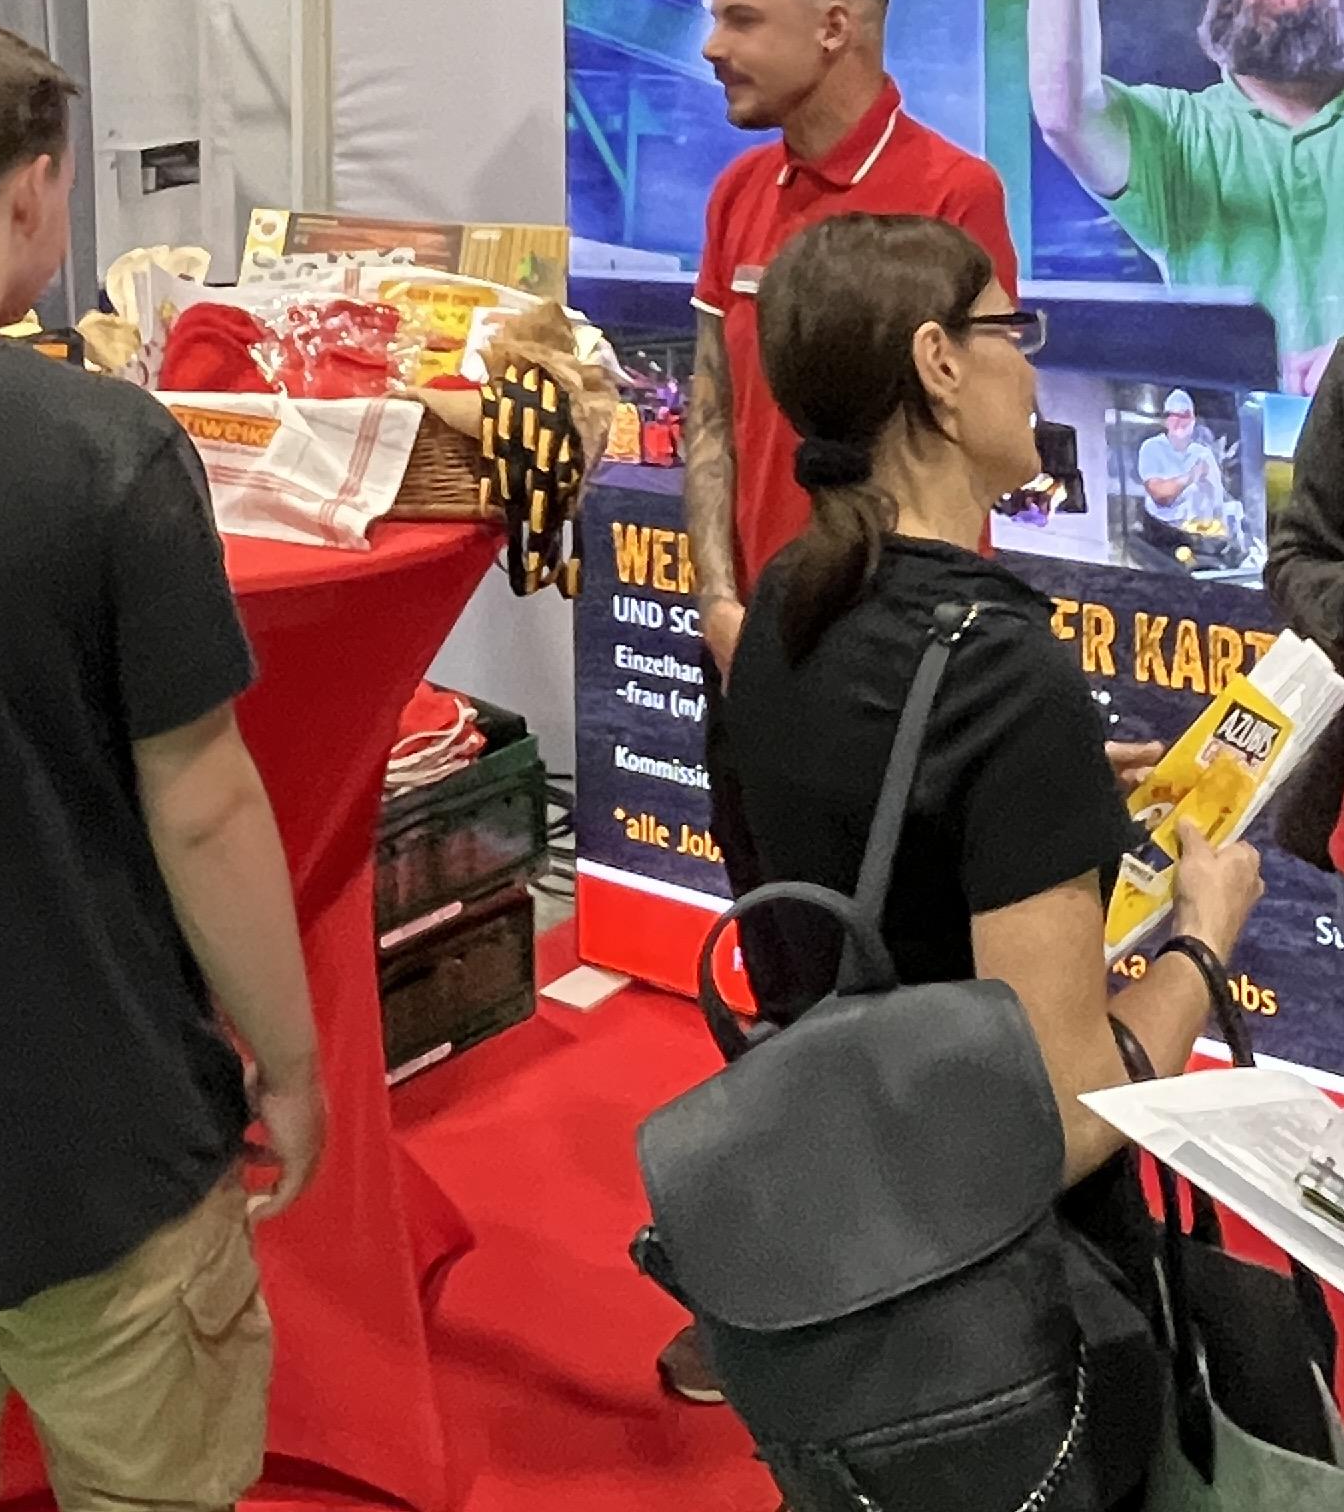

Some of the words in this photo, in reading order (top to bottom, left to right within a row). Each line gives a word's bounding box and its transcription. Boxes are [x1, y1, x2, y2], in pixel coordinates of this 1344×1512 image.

[612, 594, 664, 629] UND
[669, 606, 704, 637] SC
[614, 644, 704, 686] Einzelhan
[614, 745, 711, 790] Kommissi
